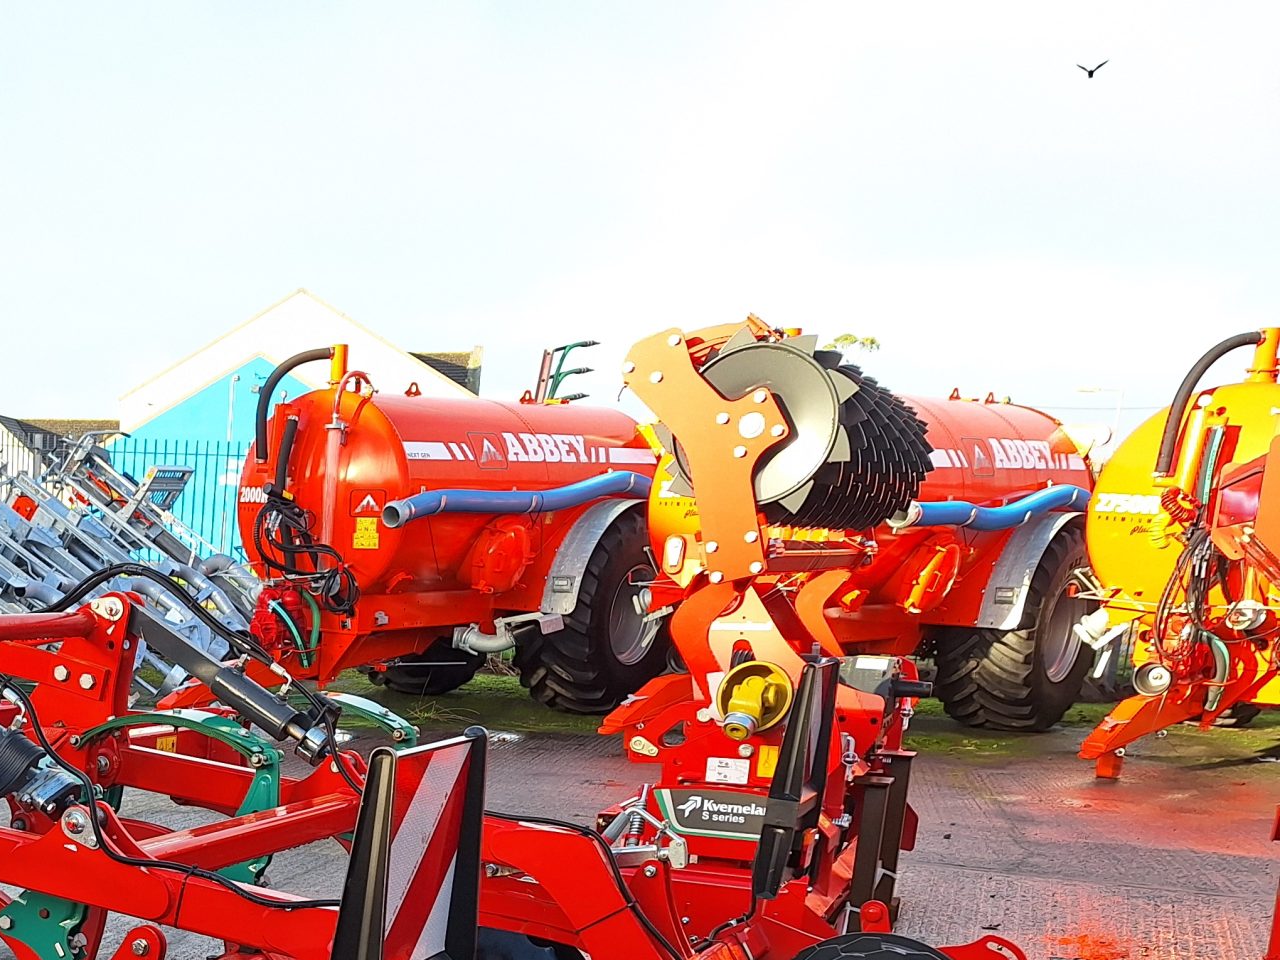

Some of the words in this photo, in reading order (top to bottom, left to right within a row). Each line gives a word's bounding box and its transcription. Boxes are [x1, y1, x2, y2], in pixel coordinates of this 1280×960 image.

[501, 432, 589, 462] ABBEY
[987, 438, 1055, 469] ABBEY
[1098, 515, 1152, 524] PREMIUM
[701, 811, 710, 820] S
[712, 813, 745, 824] series
